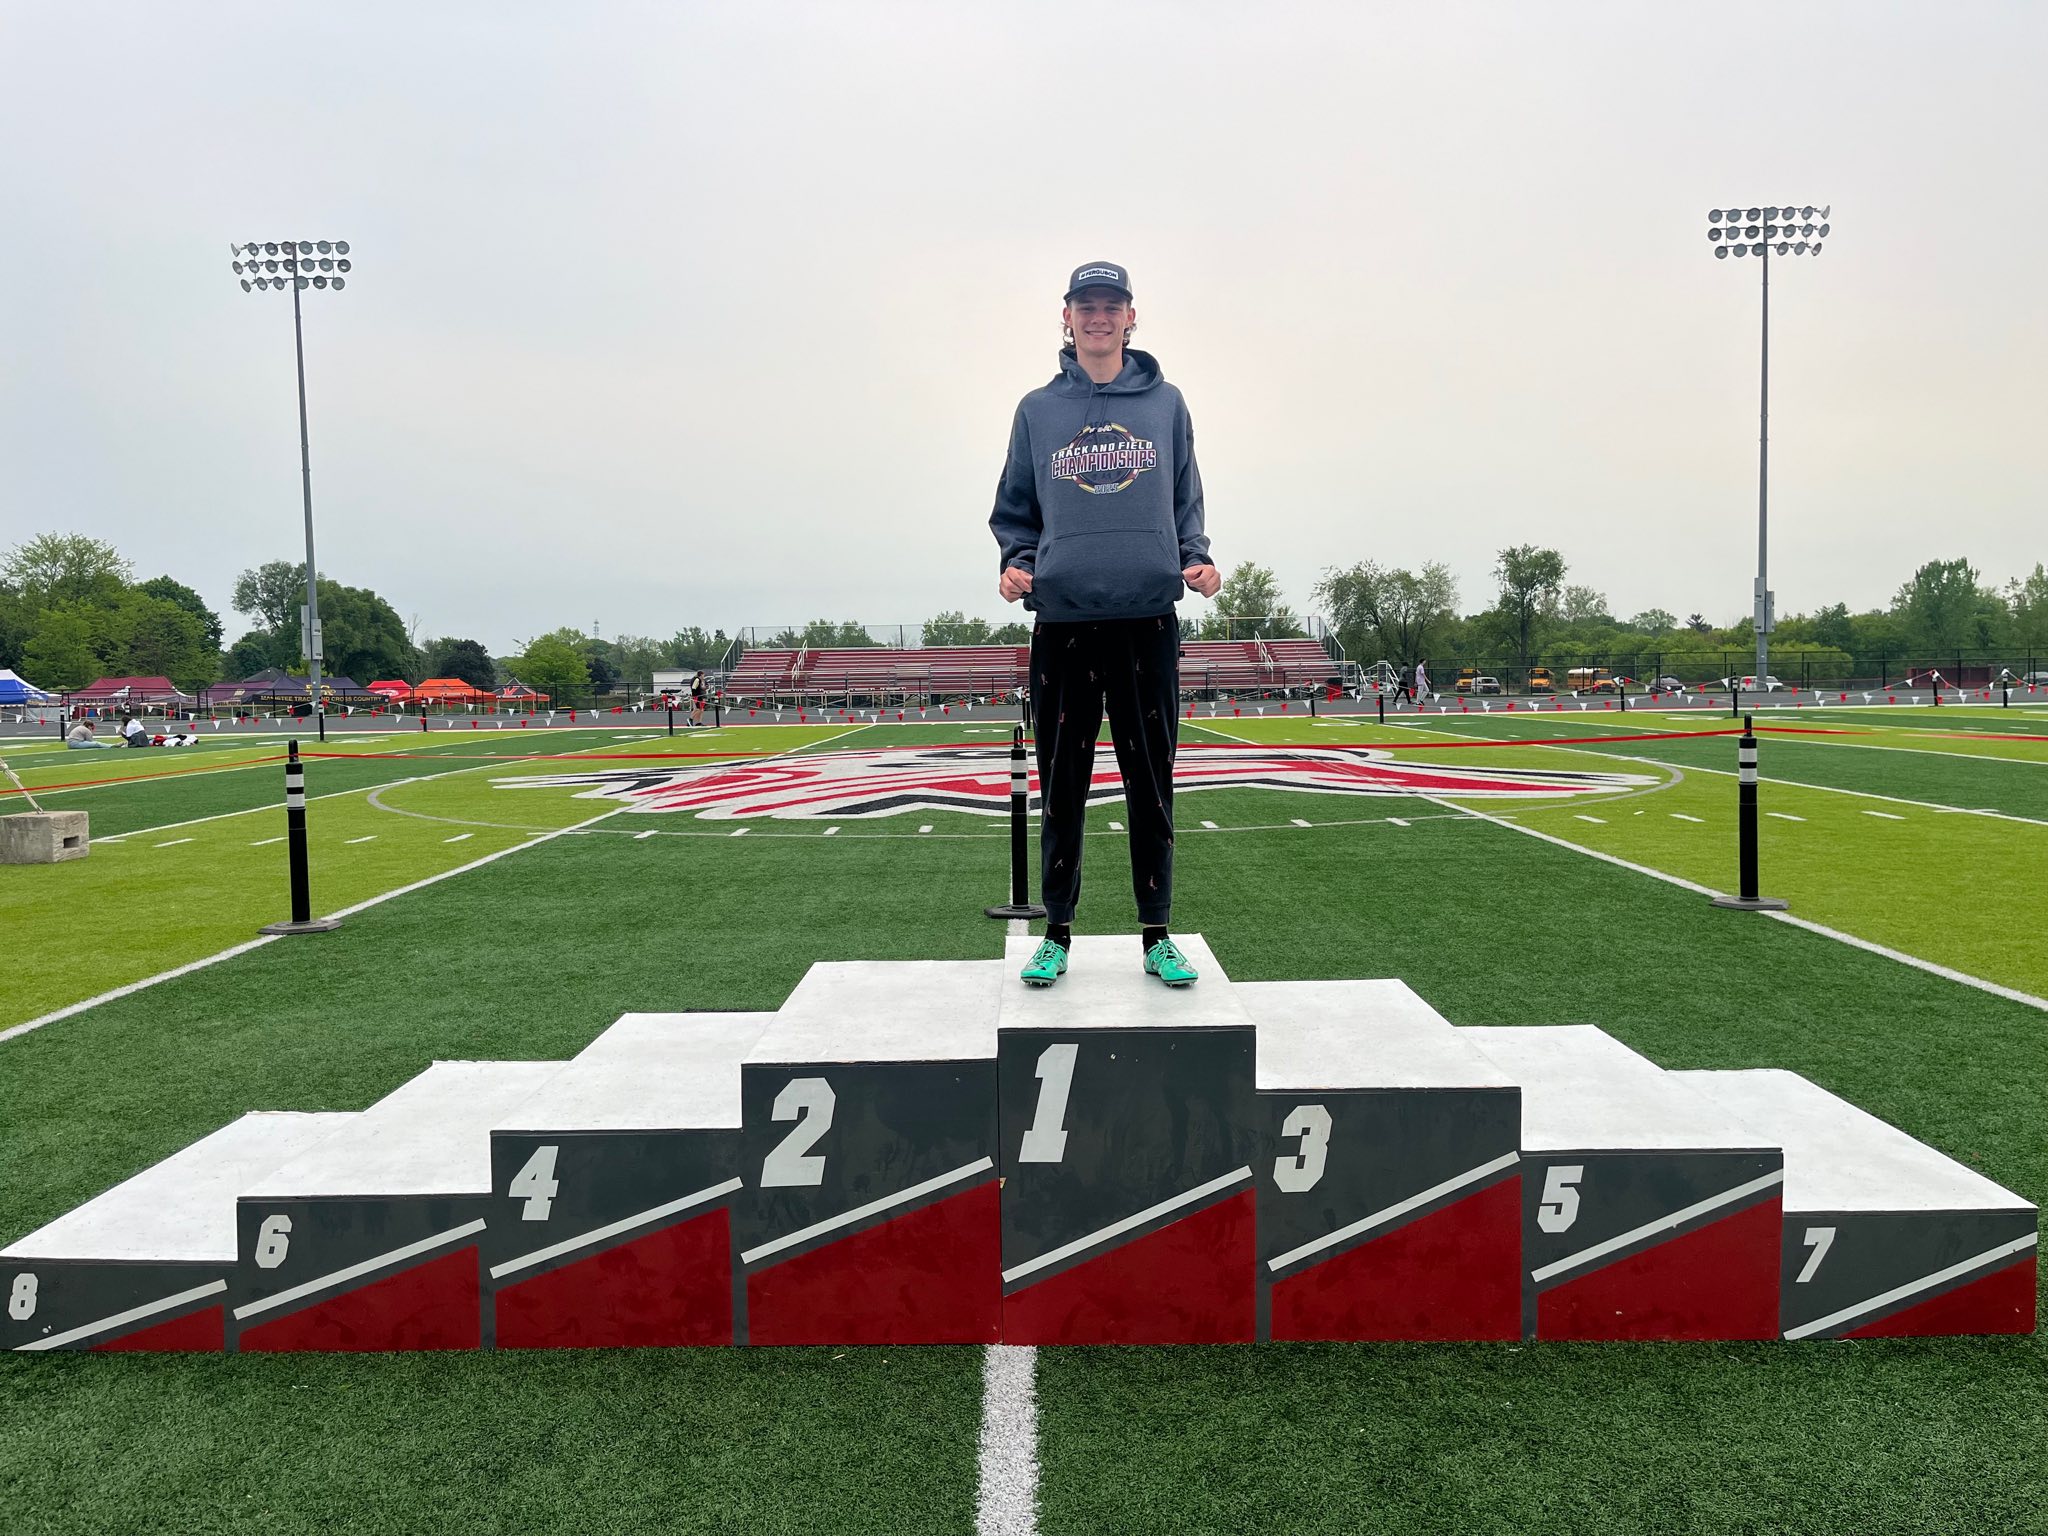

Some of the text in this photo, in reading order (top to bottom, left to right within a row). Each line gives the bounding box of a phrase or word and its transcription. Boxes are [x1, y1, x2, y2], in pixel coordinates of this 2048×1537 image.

[1051, 441, 1153, 461] TRACK AND FIELD
[1051, 448, 1157, 480] CHAMPIONSHIPS
[760, 1077, 837, 1188] 2
[1018, 1043, 1080, 1163] 1
[1272, 1104, 1333, 1193] 3
[508, 1146, 559, 1221] 4
[1537, 1165, 1585, 1233] 5
[254, 1215, 293, 1269] 6
[1796, 1227, 1836, 1283] 7
[8, 1273, 39, 1321] 8
